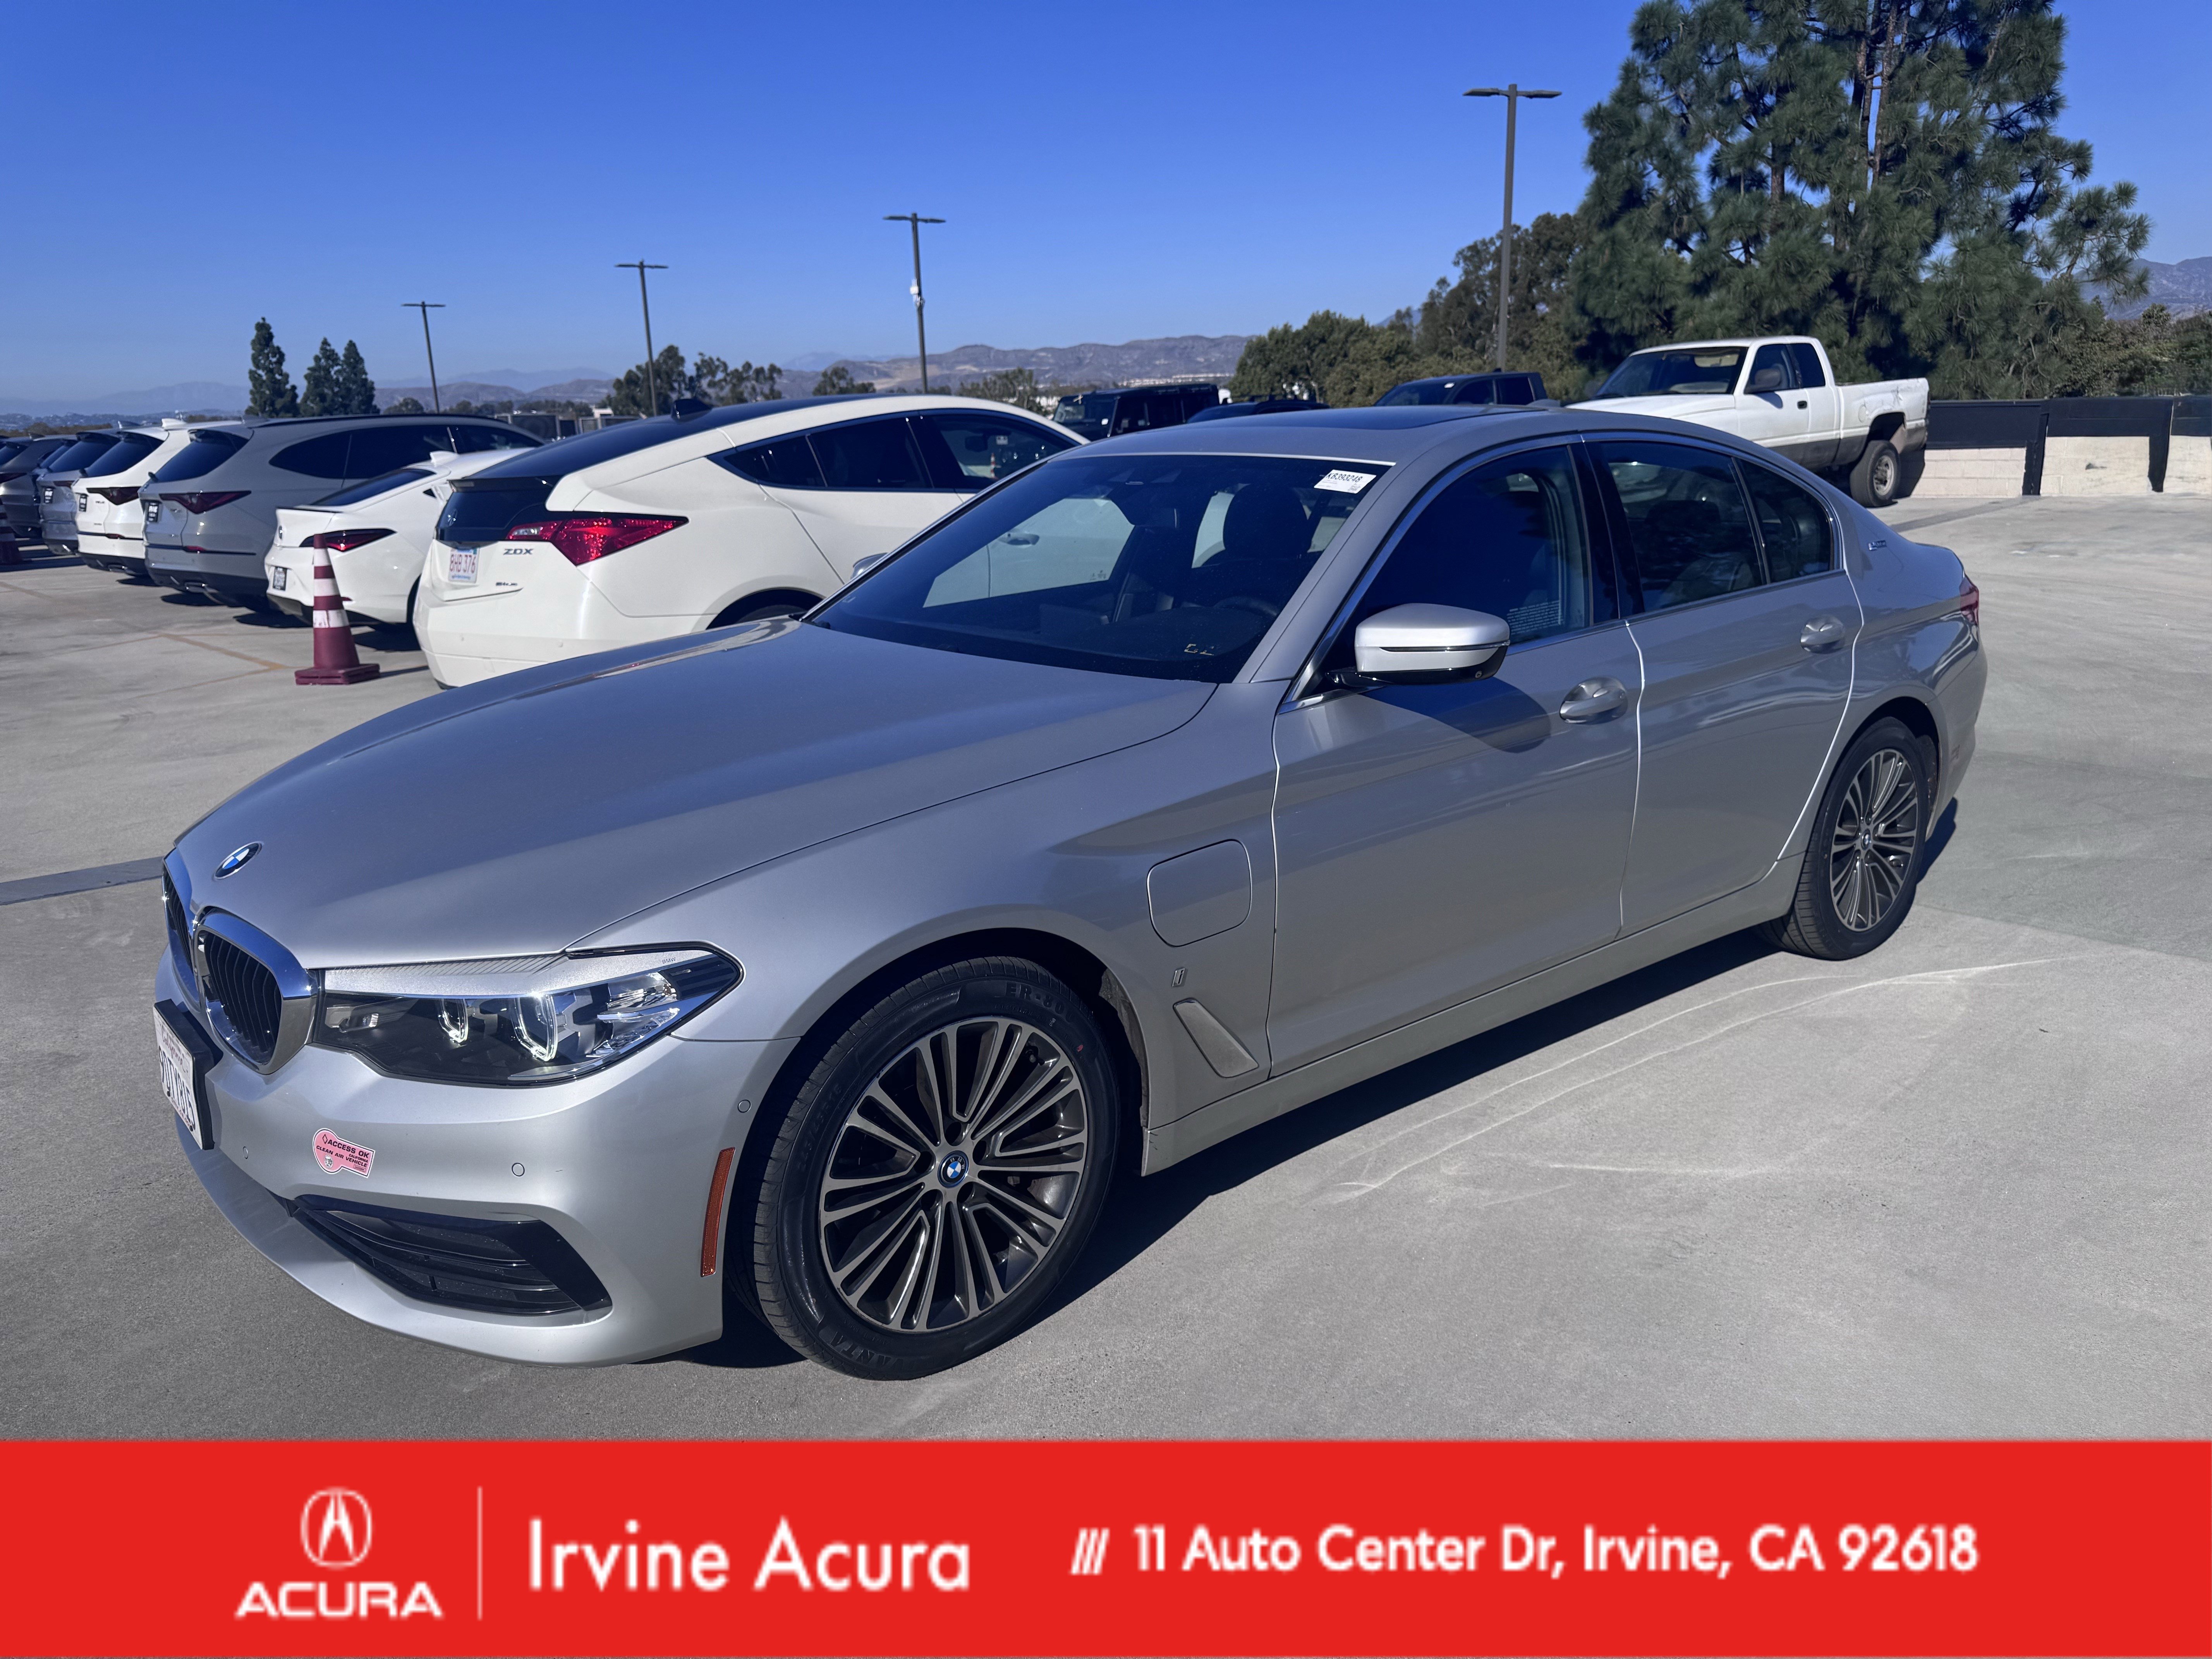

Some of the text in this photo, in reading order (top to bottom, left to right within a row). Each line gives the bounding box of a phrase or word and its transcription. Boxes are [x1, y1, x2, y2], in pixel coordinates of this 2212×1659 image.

[463, 554, 476, 574] 376
[316, 1145, 333, 1155] CLEAN
[346, 1156, 368, 1168] VEHICLE
[327, 1139, 370, 1158] ACCESS OK
[349, 1154, 368, 1163] CALIFORNIA
[950, 1156, 965, 1169] BMW
